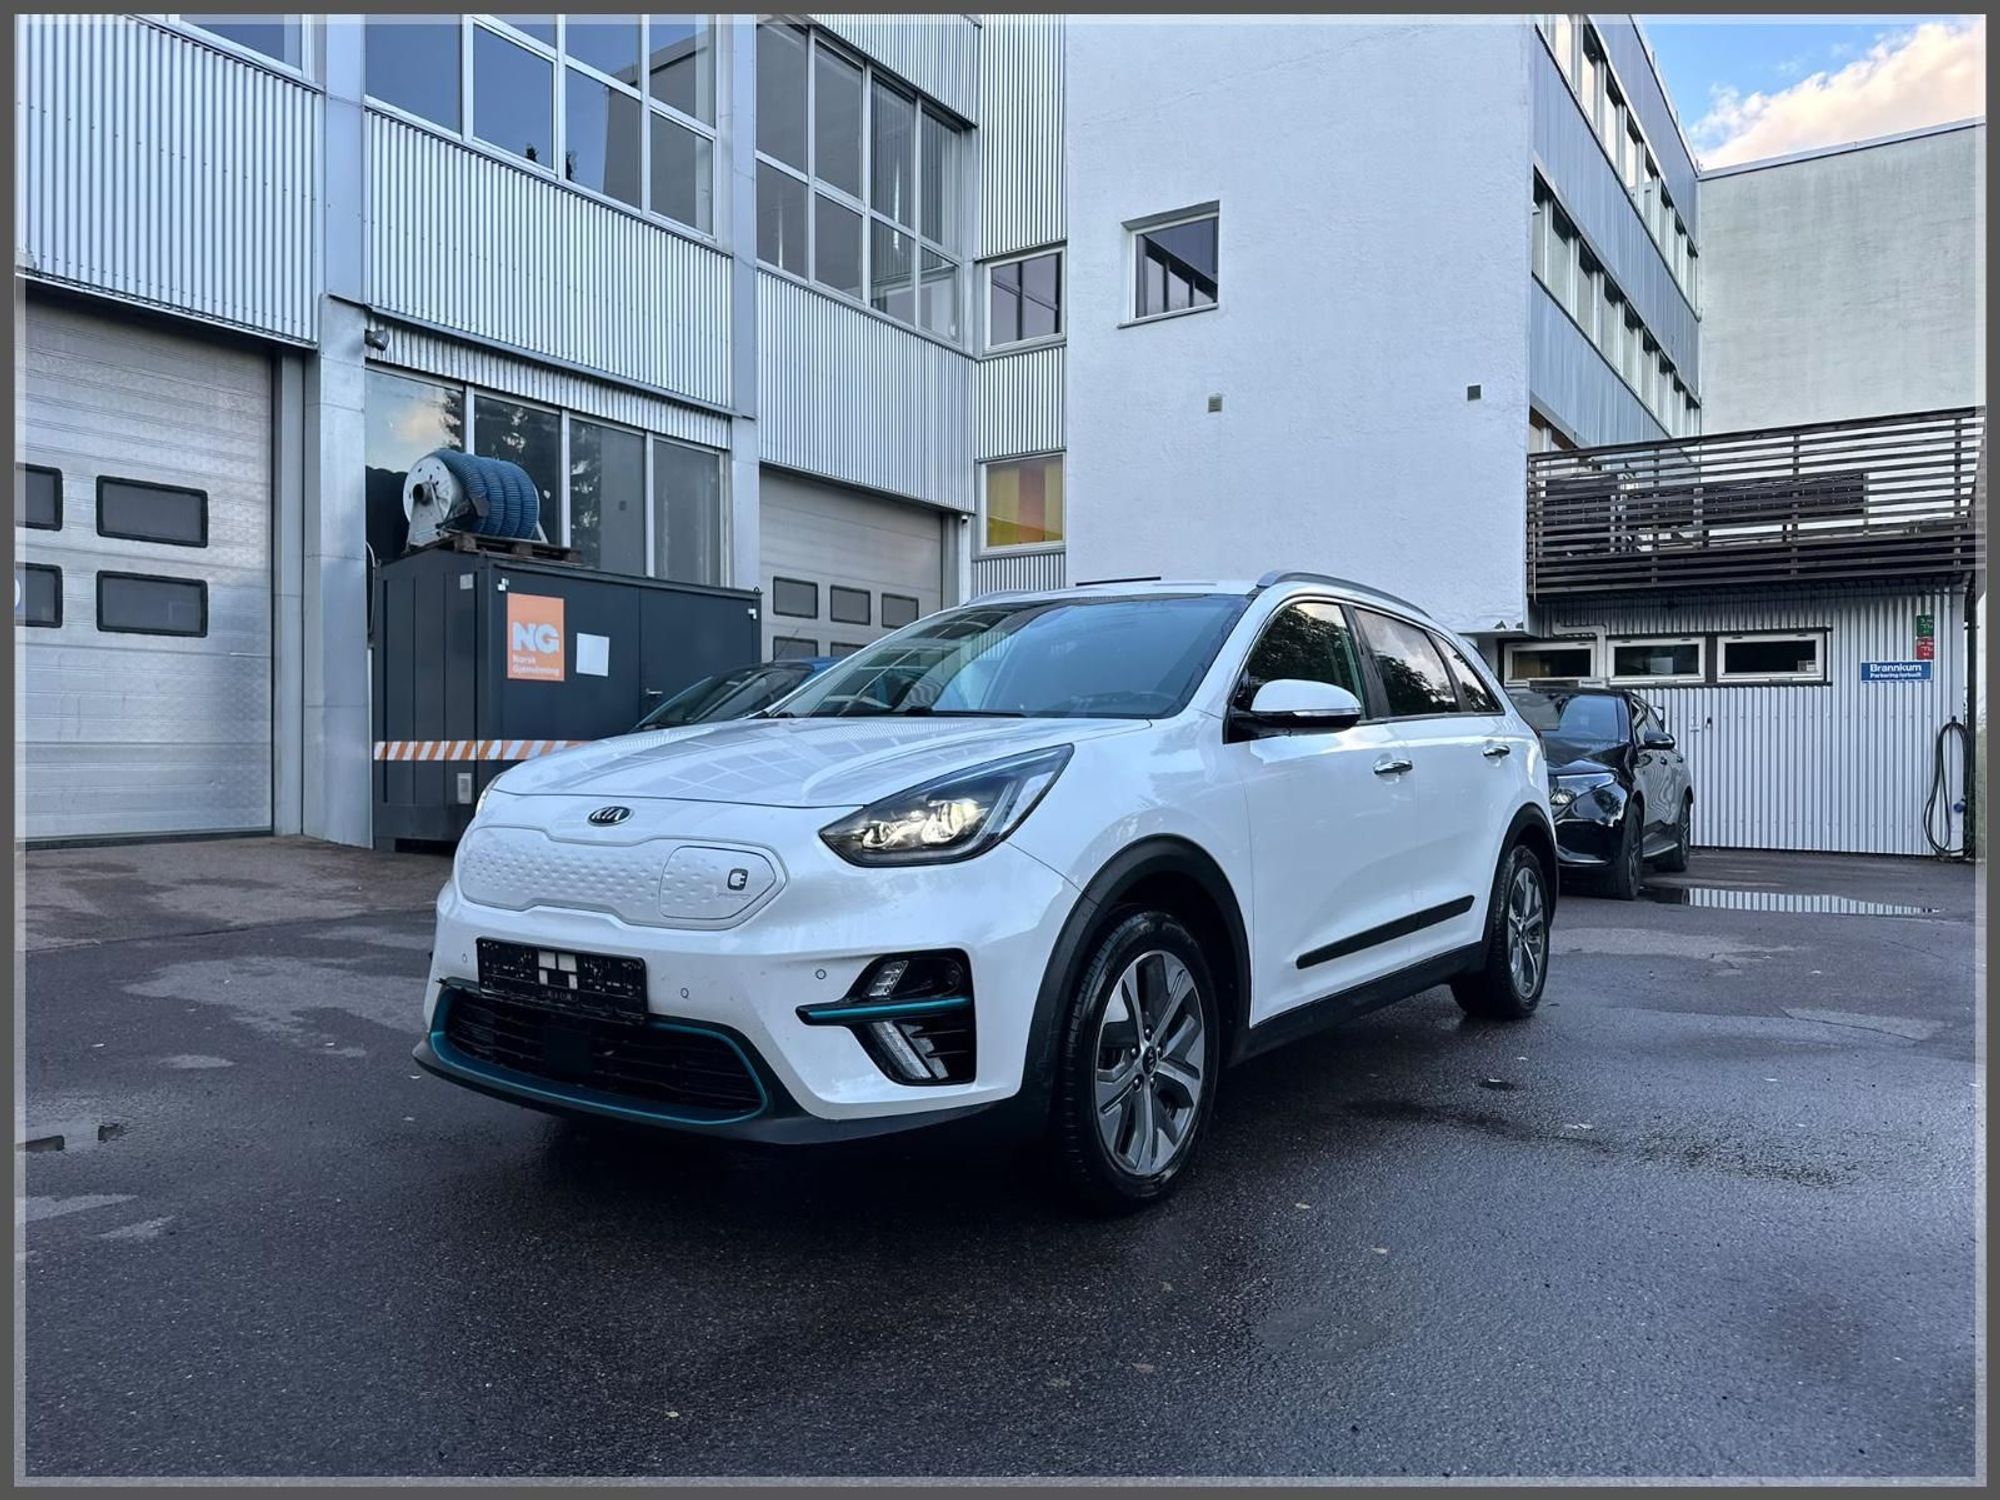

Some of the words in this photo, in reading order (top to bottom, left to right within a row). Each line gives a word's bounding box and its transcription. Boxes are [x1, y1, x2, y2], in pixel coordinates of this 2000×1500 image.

[512, 621, 560, 654] NG
[1869, 663, 1922, 673] Brannkum
[591, 808, 624, 820] KIA
